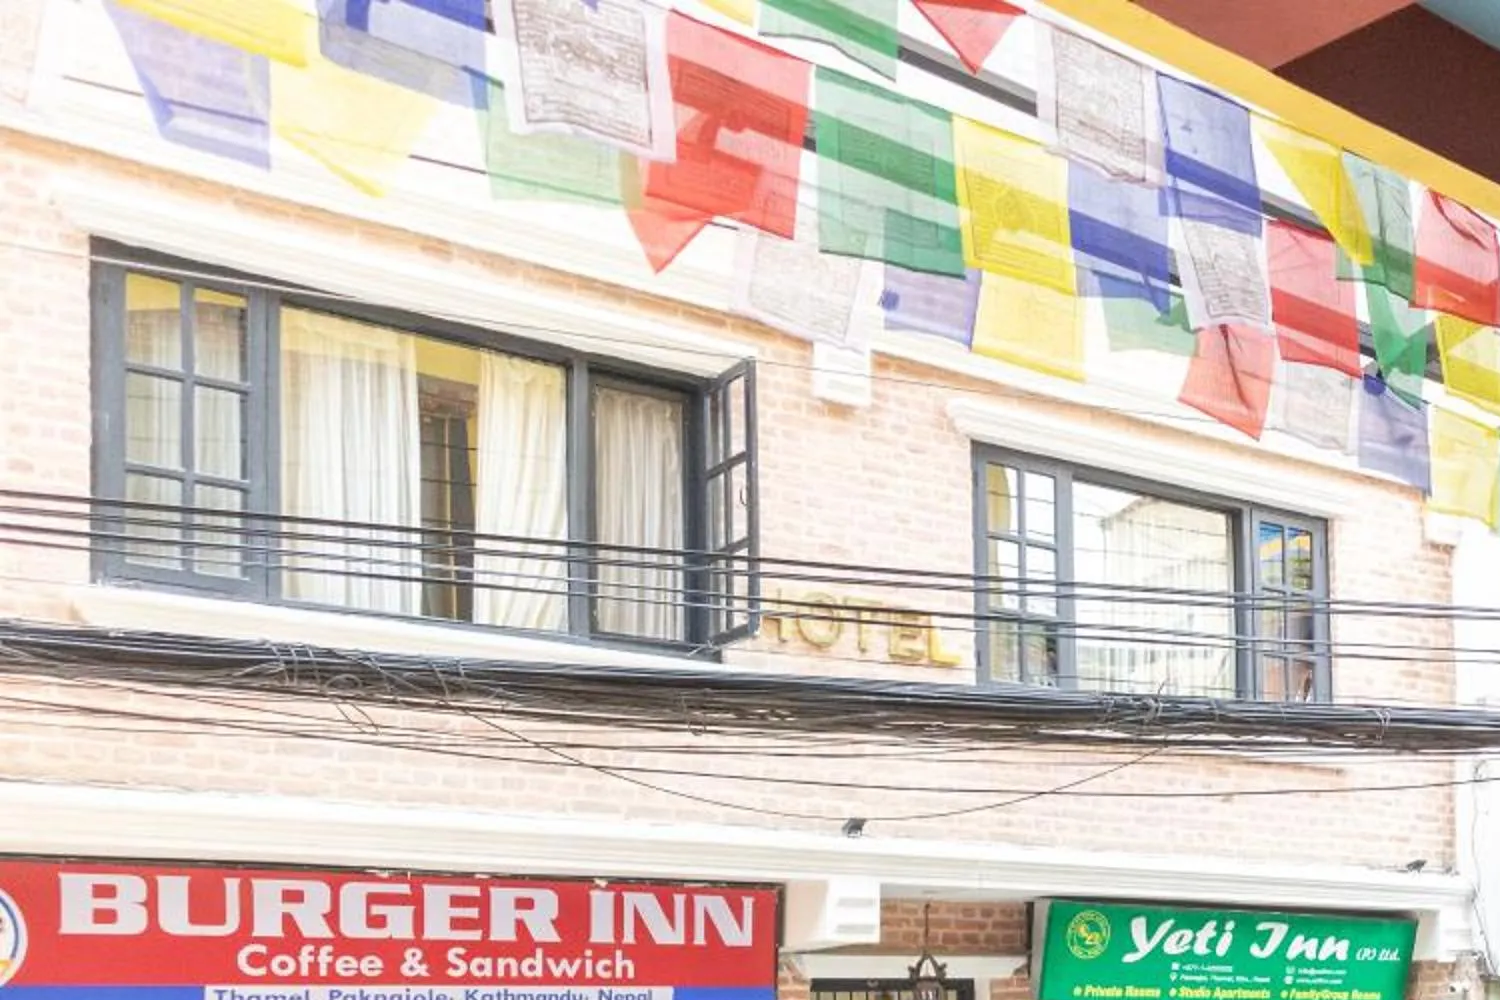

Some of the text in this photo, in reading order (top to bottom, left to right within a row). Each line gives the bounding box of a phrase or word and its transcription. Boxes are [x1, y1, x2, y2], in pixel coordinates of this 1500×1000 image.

[57, 872, 756, 948] BURGER INN
[236, 944, 636, 980] Coffee & Sandwich
[1121, 915, 1236, 963] Yeti
[1249, 921, 1351, 961] Inn
